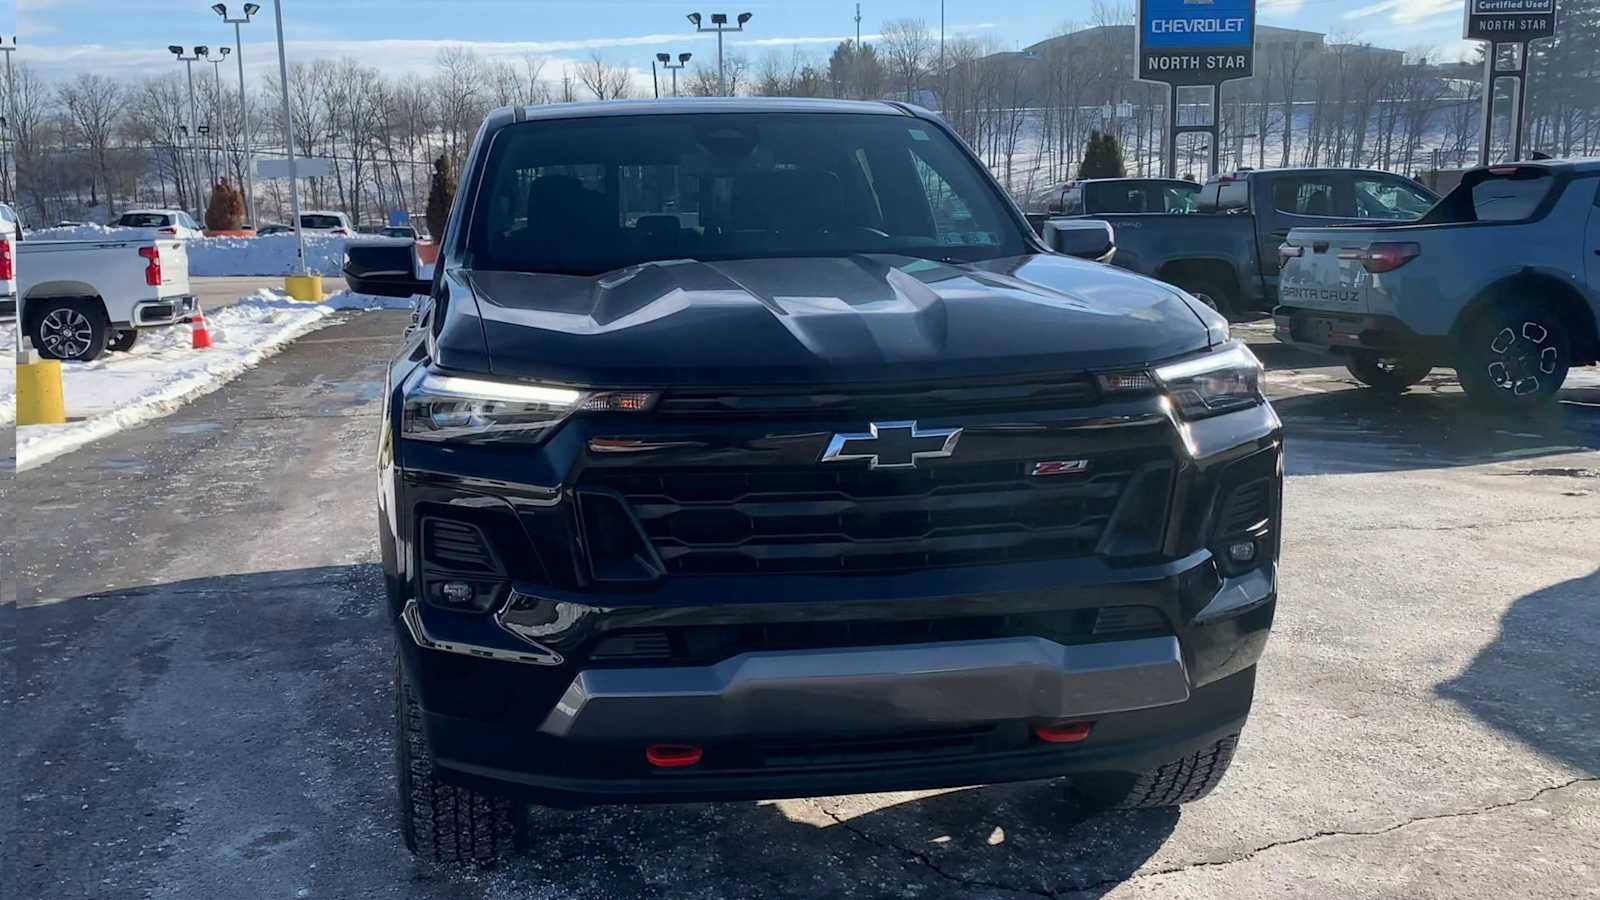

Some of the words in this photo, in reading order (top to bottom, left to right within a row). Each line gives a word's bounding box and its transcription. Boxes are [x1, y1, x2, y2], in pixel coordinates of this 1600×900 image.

[1479, 0, 1523, 9] Certified
[1525, 0, 1549, 8] Used
[1151, 18, 1245, 33] CHEVROLET
[1479, 20, 1516, 31] NORTH
[1520, 19, 1547, 30] STAR
[1148, 56, 1200, 70] NORTH
[1206, 55, 1246, 69] STAR
[1283, 286, 1318, 299] SANTA
[1321, 289, 1360, 302] CRUZ
